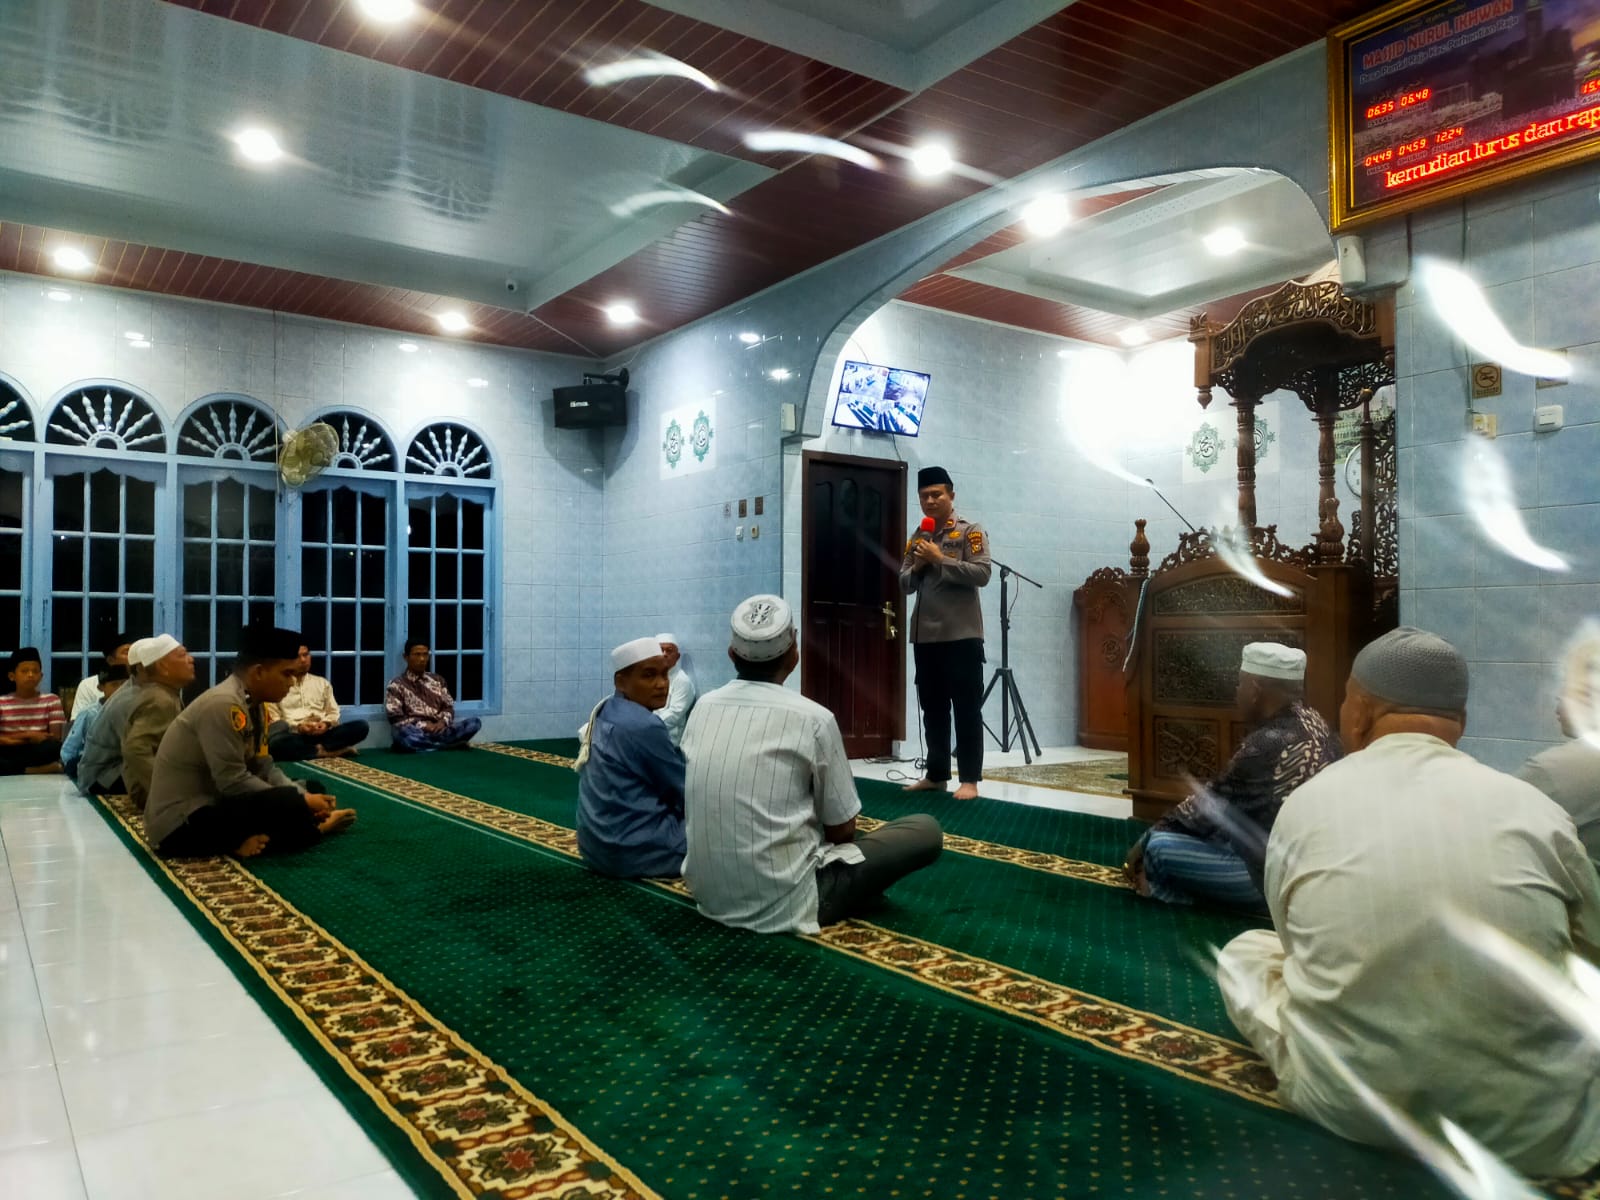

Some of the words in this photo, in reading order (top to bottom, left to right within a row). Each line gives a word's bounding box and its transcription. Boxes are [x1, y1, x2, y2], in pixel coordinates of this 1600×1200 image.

[1362, 40, 1406, 70] MASJID
[1407, 20, 1453, 52] NURUL
[1473, 133, 1521, 160] lurus
[1523, 122, 1564, 143] dan
